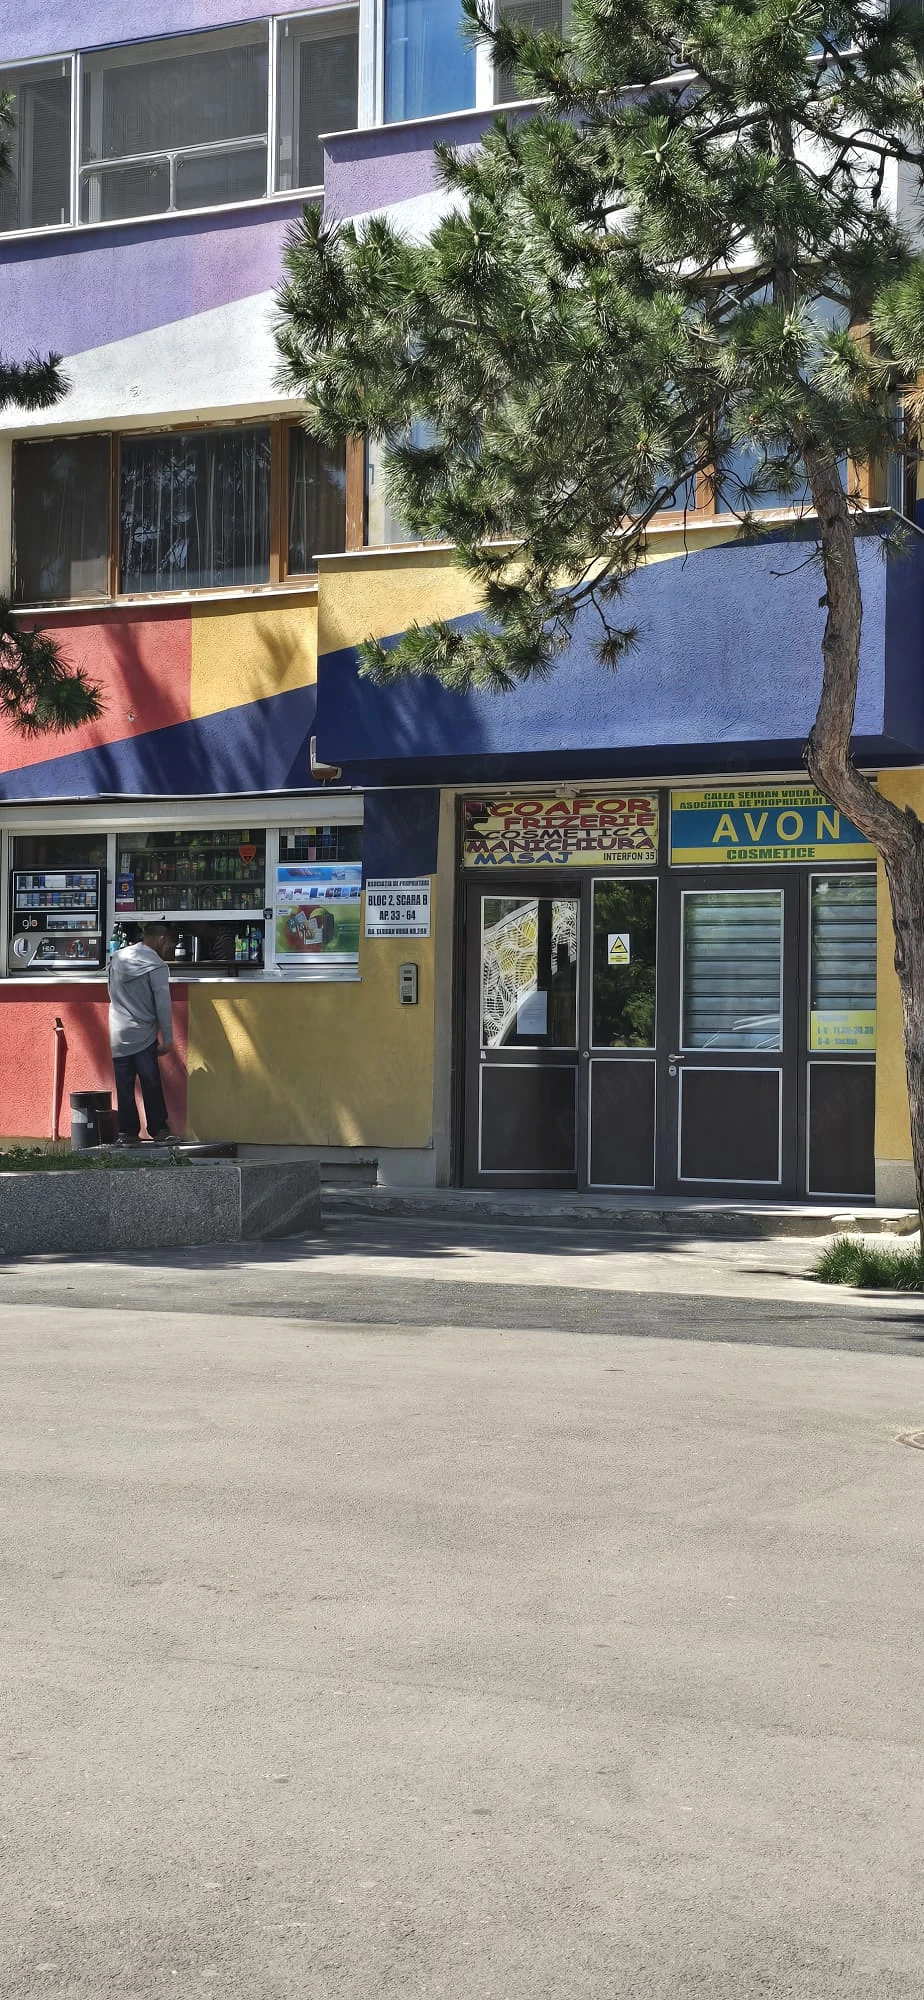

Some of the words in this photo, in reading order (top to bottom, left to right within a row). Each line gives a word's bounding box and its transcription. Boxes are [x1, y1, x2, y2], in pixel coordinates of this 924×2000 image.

[704, 792, 735, 800] CALEA
[738, 790, 779, 799] SERBAN
[781, 789, 810, 798] VODA
[490, 799, 652, 817] COAFOR
[679, 800, 734, 809] ASOCIATIA
[739, 799, 753, 807] DE
[754, 797, 823, 806] PROPRIETARI
[503, 813, 657, 830] FRIZERIE
[712, 810, 841, 843] AVON
[483, 827, 649, 840] COSMETICA
[466, 837, 656, 853] MANICHIURA
[473, 851, 573, 865] MASAJ
[603, 851, 643, 861] INTERFON
[645, 850, 655, 860] 35
[726, 847, 816, 860] COSMETICE
[368, 895, 387, 906] BLOC
[396, 894, 421, 906] SCARA
[422, 894, 428, 905] B
[406, 910, 416, 920] 64
